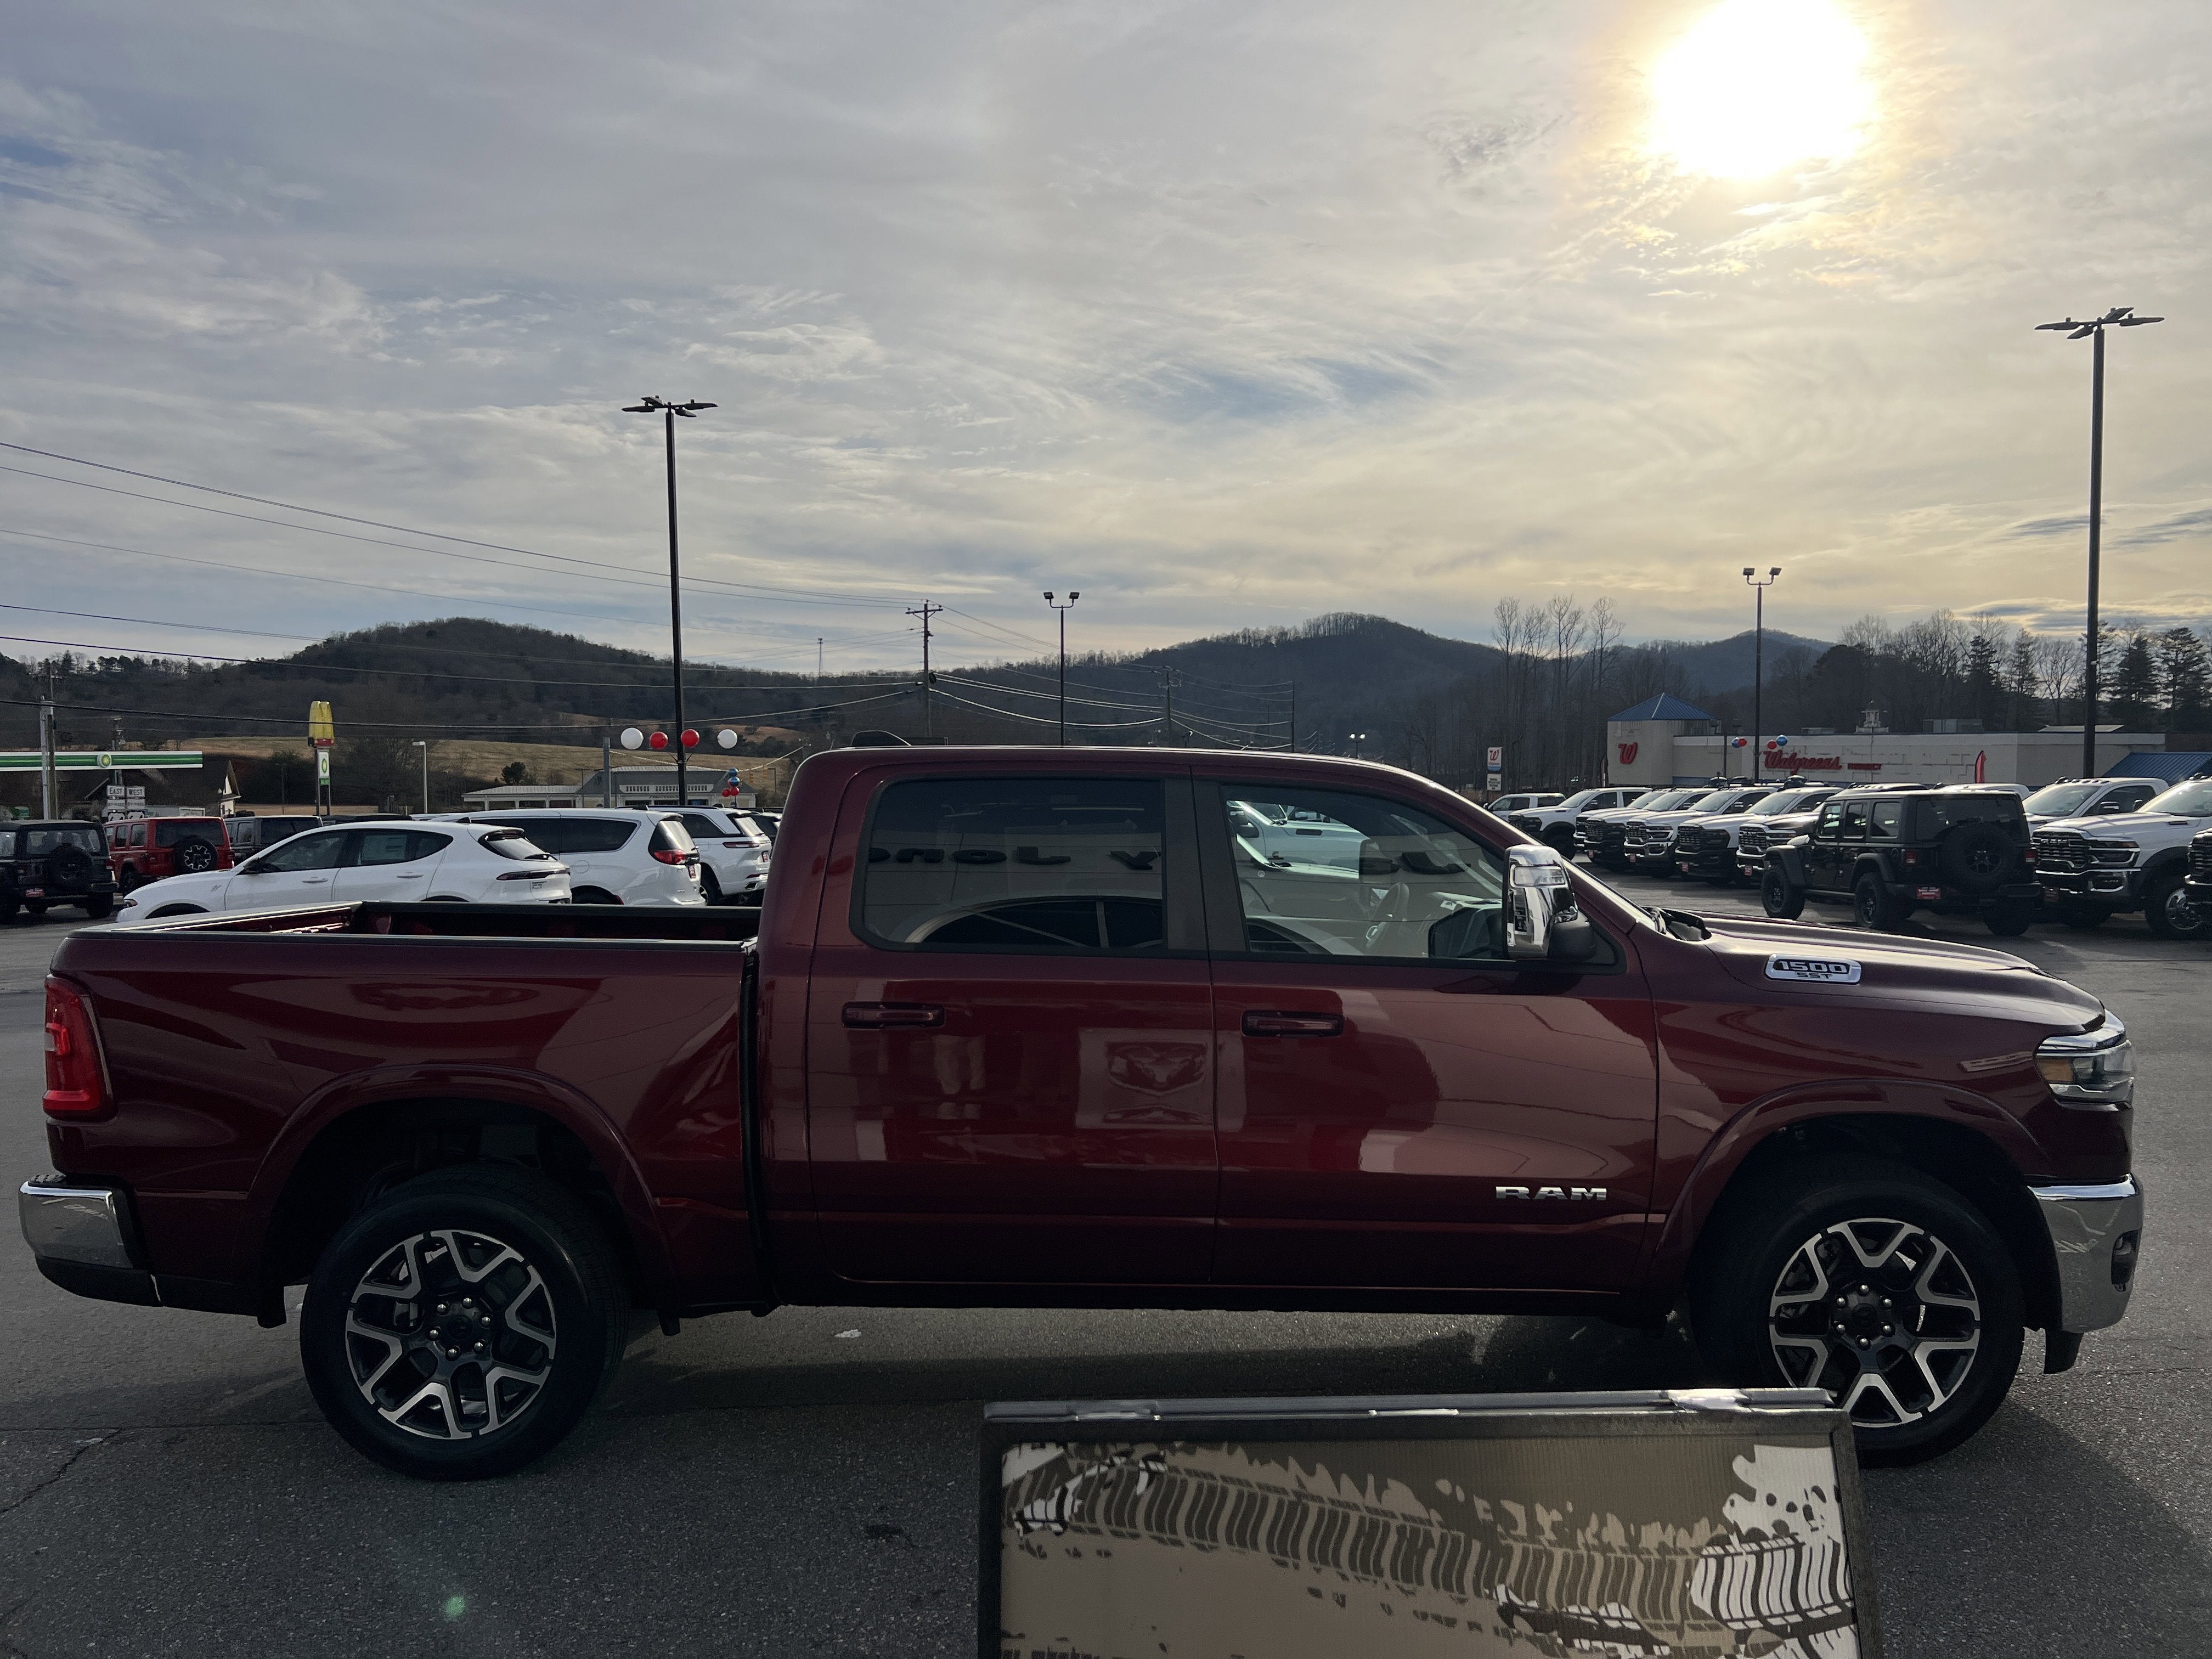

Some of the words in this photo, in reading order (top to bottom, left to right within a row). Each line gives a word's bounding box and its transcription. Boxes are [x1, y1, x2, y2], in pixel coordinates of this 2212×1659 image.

[1763, 749, 1842, 775] Walgreens
[1779, 961, 1848, 973] 1500
[1496, 1186, 1607, 1200] RAM
